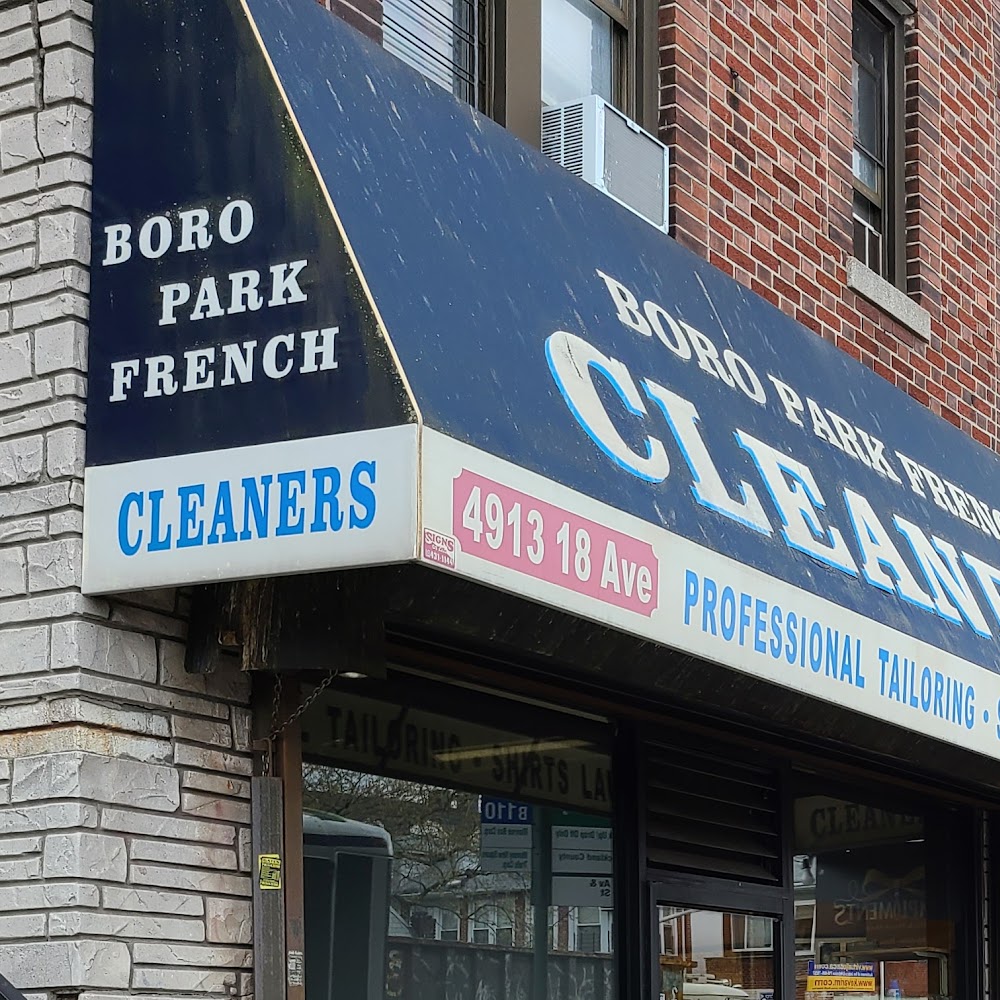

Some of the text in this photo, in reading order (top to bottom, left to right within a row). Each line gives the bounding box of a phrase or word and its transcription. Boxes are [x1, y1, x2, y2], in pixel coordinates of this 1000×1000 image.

[102, 199, 255, 267] BORO
[158, 259, 308, 326] PARK
[109, 326, 340, 403] FRENCH
[596, 269, 766, 404] BORO
[768, 374, 902, 484] PARK
[117, 460, 377, 556] CLEANERS
[425, 531, 454, 552] SIGNS
[462, 486, 652, 604] 4913 18 Ave
[684, 569, 865, 689] PROFESSIONAL
[878, 648, 975, 730] TAILORING
